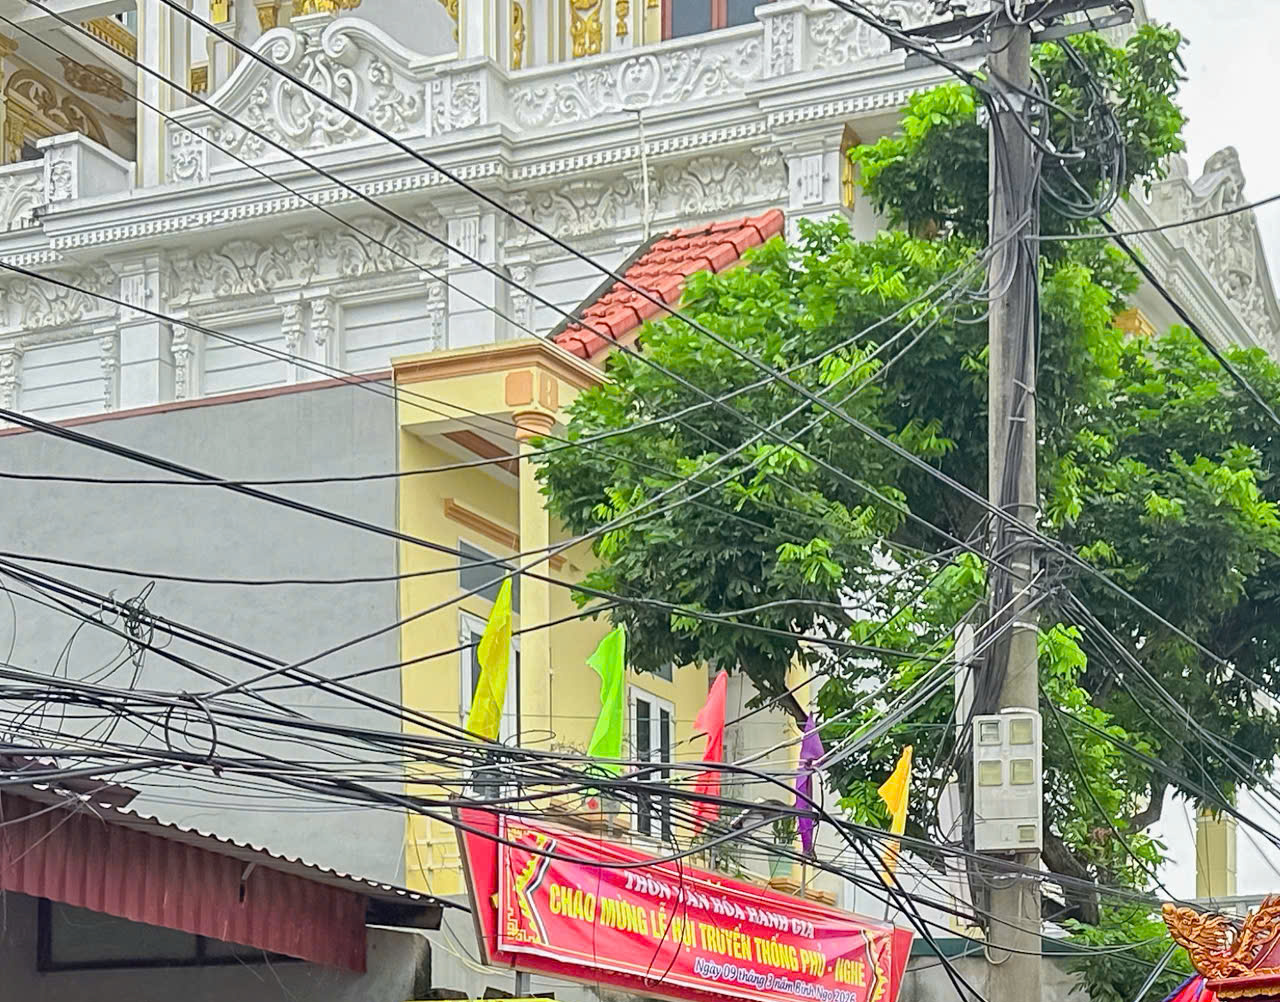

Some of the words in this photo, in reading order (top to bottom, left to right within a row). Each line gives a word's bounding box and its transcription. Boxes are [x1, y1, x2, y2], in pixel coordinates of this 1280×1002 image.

[550, 883, 596, 923] CHÀO
[650, 902, 670, 941] LỄ
[753, 933, 799, 972] THỐNG
[624, 870, 671, 900] THÔN
[791, 918, 815, 939] GIA
[695, 957, 722, 980] Ngày
[723, 963, 737, 981] 09
[765, 973, 775, 988] 3
